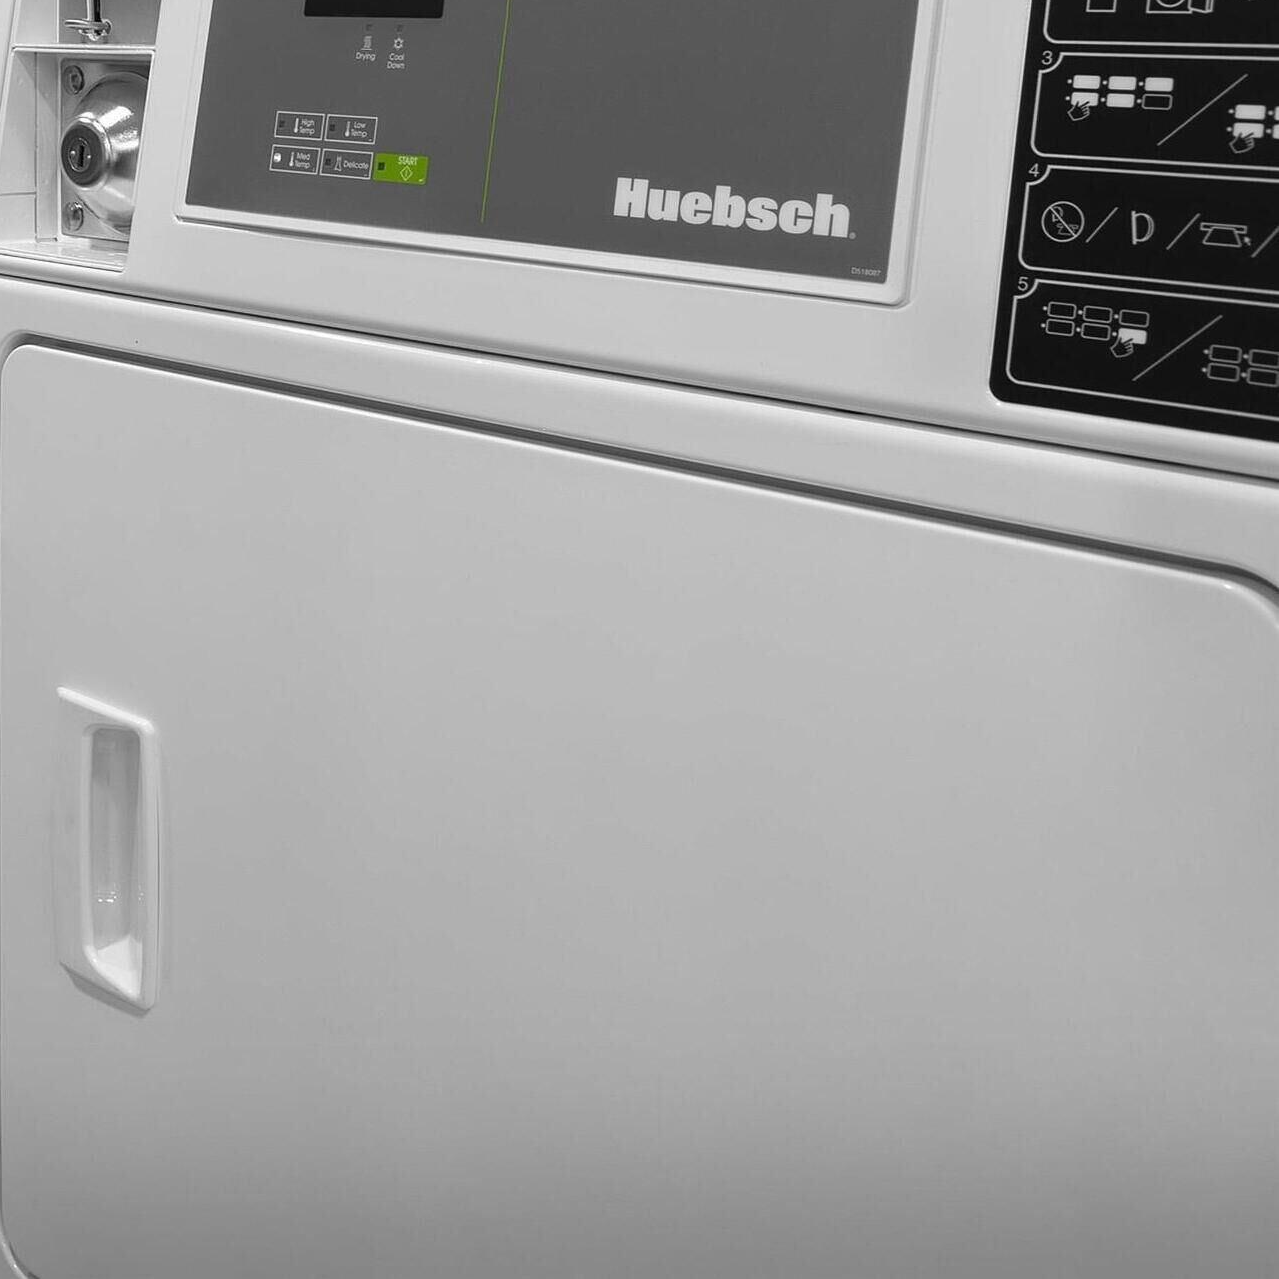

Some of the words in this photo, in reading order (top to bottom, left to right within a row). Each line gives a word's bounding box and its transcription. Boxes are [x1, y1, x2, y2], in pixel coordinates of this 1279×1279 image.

[355, 52, 376, 62] Drying
[389, 52, 405, 61] Cool
[1042, 50, 1054, 66] 3
[353, 121, 367, 129] Low
[299, 126, 316, 136] Temp
[351, 128, 368, 138] Temp
[296, 152, 311, 161] Med
[397, 155, 419, 166] START
[295, 160, 311, 169] Temp
[342, 160, 370, 170] Delicate
[1028, 163, 1040, 178] 4
[613, 177, 851, 238] Huebsch
[1017, 276, 1029, 292] 5
